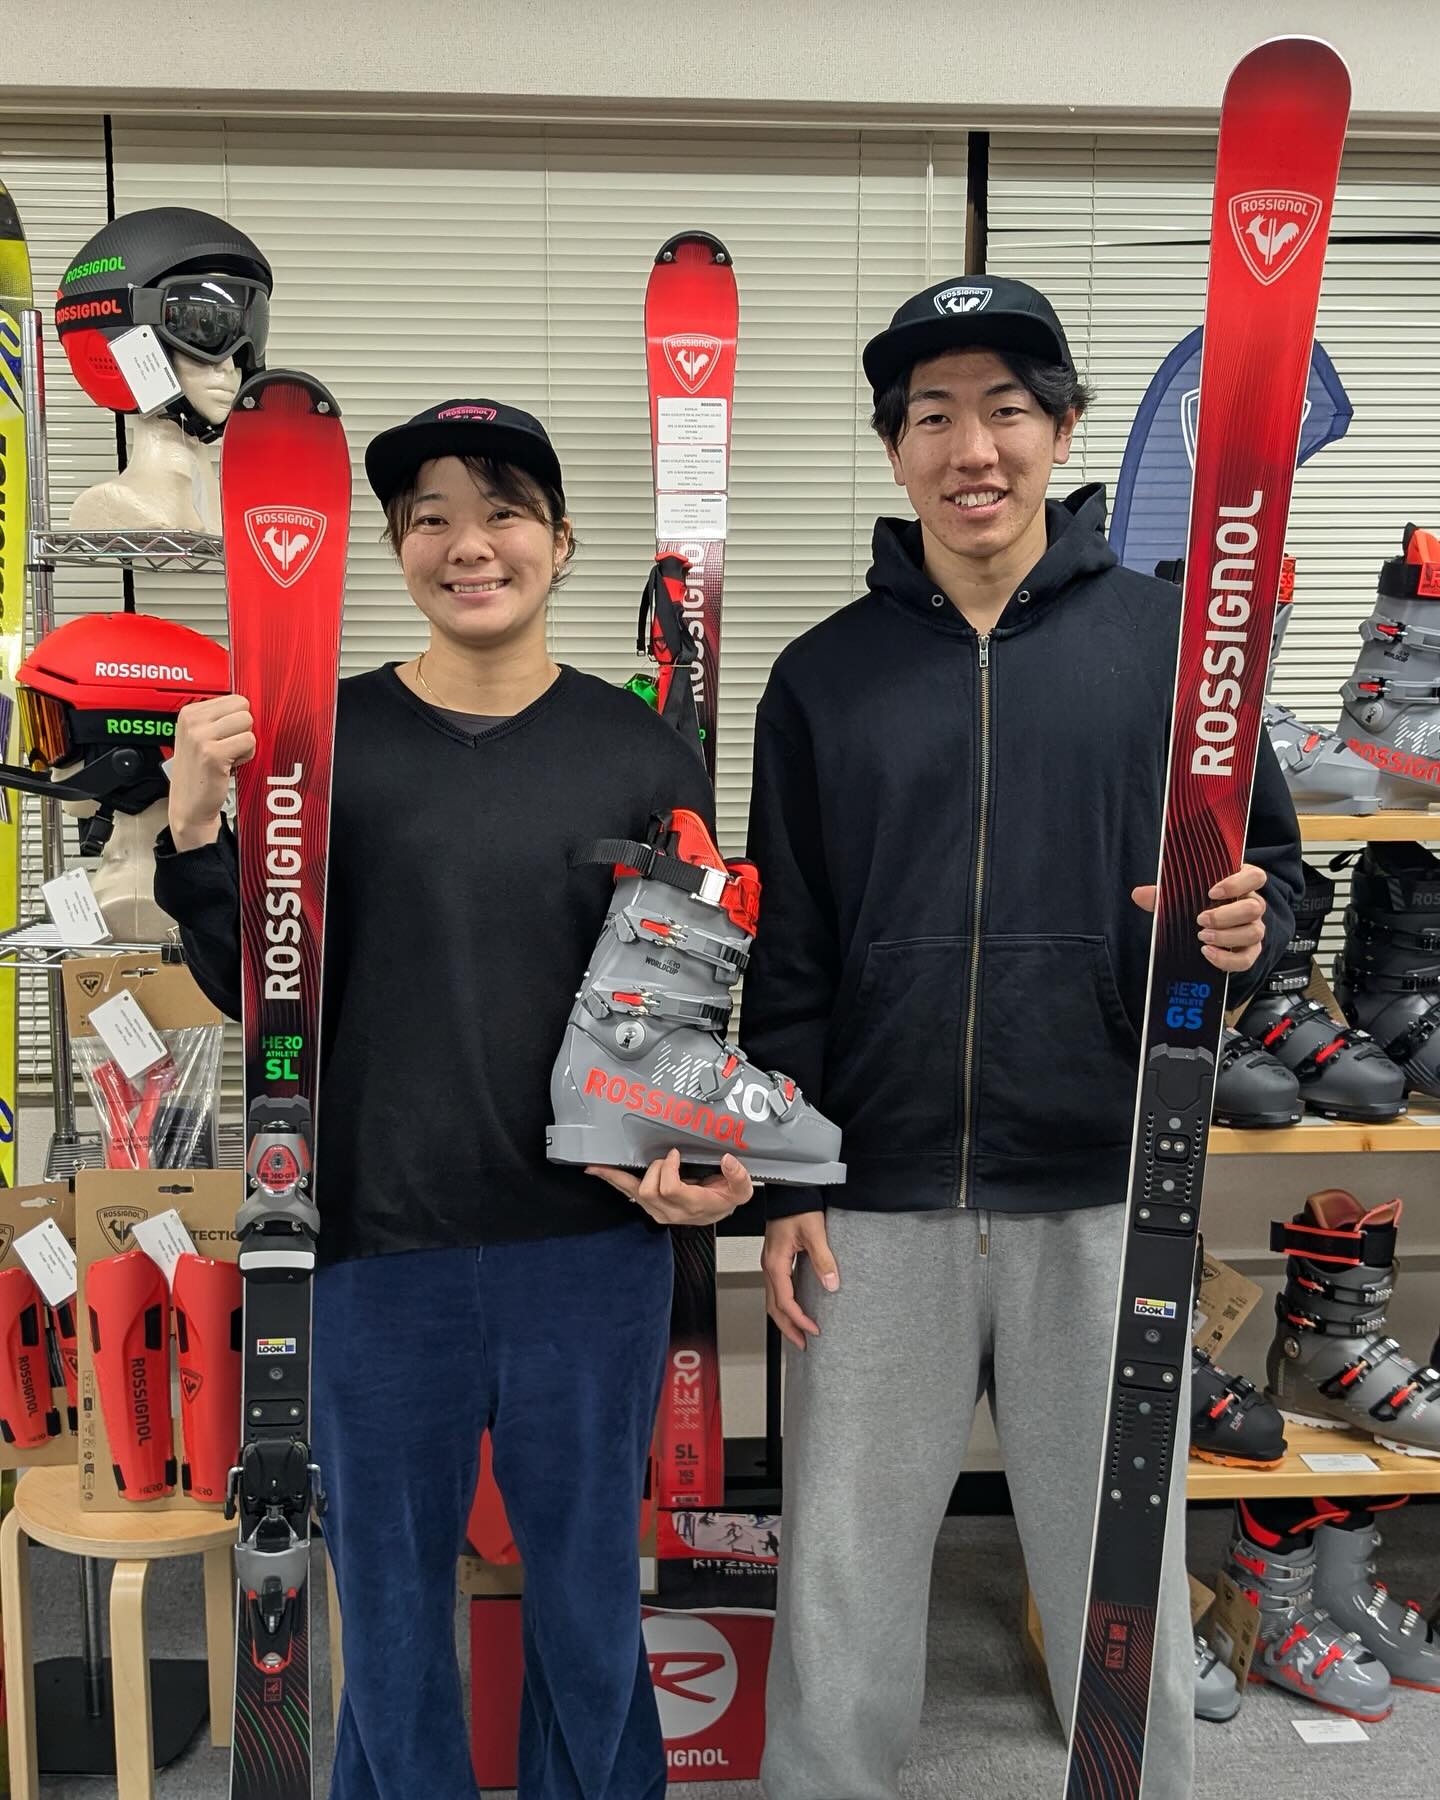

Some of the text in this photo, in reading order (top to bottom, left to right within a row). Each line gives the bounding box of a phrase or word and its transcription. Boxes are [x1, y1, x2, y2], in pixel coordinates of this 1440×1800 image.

[1241, 199, 1308, 216] ROSSIGNOL
[65, 256, 126, 285] ROSSIGNOL
[941, 289, 985, 301] ROSSIGNOL
[56, 299, 123, 325] ROSSIGNOL
[671, 339, 713, 350] ROSSIGNOL
[255, 513, 317, 529] ROSSIGNOL
[1191, 490, 1264, 777] ROSSIGNOL
[95, 662, 193, 681] ROSSIGNOL
[107, 719, 177, 736] ROSSIG
[265, 763, 303, 1000] ROSSIGNOL
[645, 956, 679, 976] WORLDCUP
[1167, 982, 1210, 998] HERO
[1167, 1006, 1203, 1030] GS
[262, 1036, 303, 1049] HERO
[265, 1059, 299, 1080] SL
[584, 1066, 749, 1150] ROSSIGNOL
[103, 1210, 141, 1219] ROSSIGNOL
[1136, 1305, 1163, 1315] LOOK
[259, 1345, 284, 1353] LOOK
[19, 1355, 38, 1418] ROSSIGNOL
[131, 1357, 152, 1446] ROSSIGNOL
[675, 1444, 699, 1460] SL
